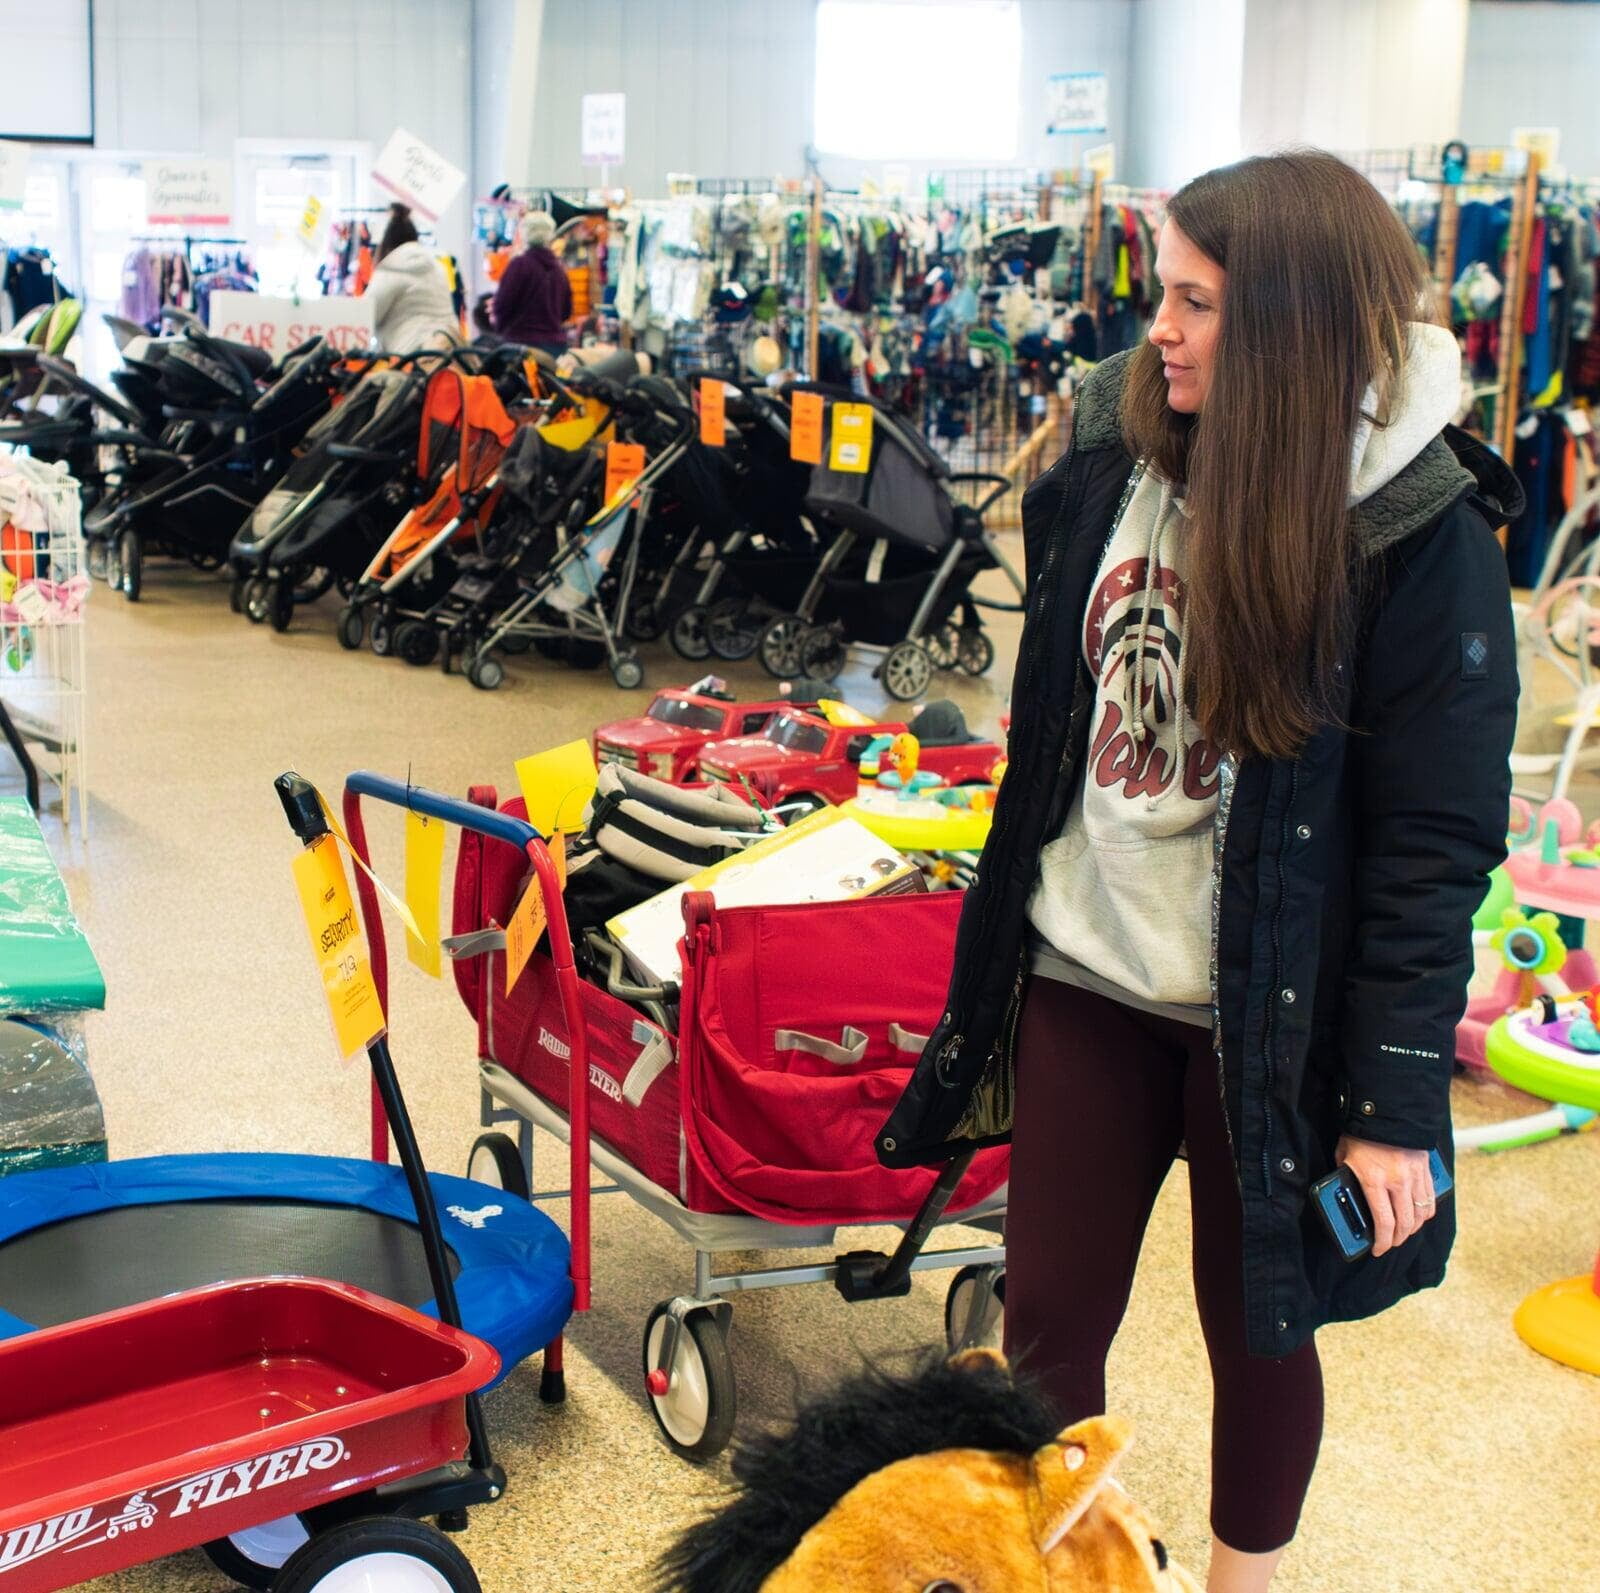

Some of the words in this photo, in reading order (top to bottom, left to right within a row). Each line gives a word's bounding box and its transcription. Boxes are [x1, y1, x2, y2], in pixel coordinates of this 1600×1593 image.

[223, 321, 275, 350] CAR
[286, 323, 370, 353] SEATS
[1380, 1044, 1440, 1059] OMNI-TECH
[169, 1437, 344, 1518] FLYER
